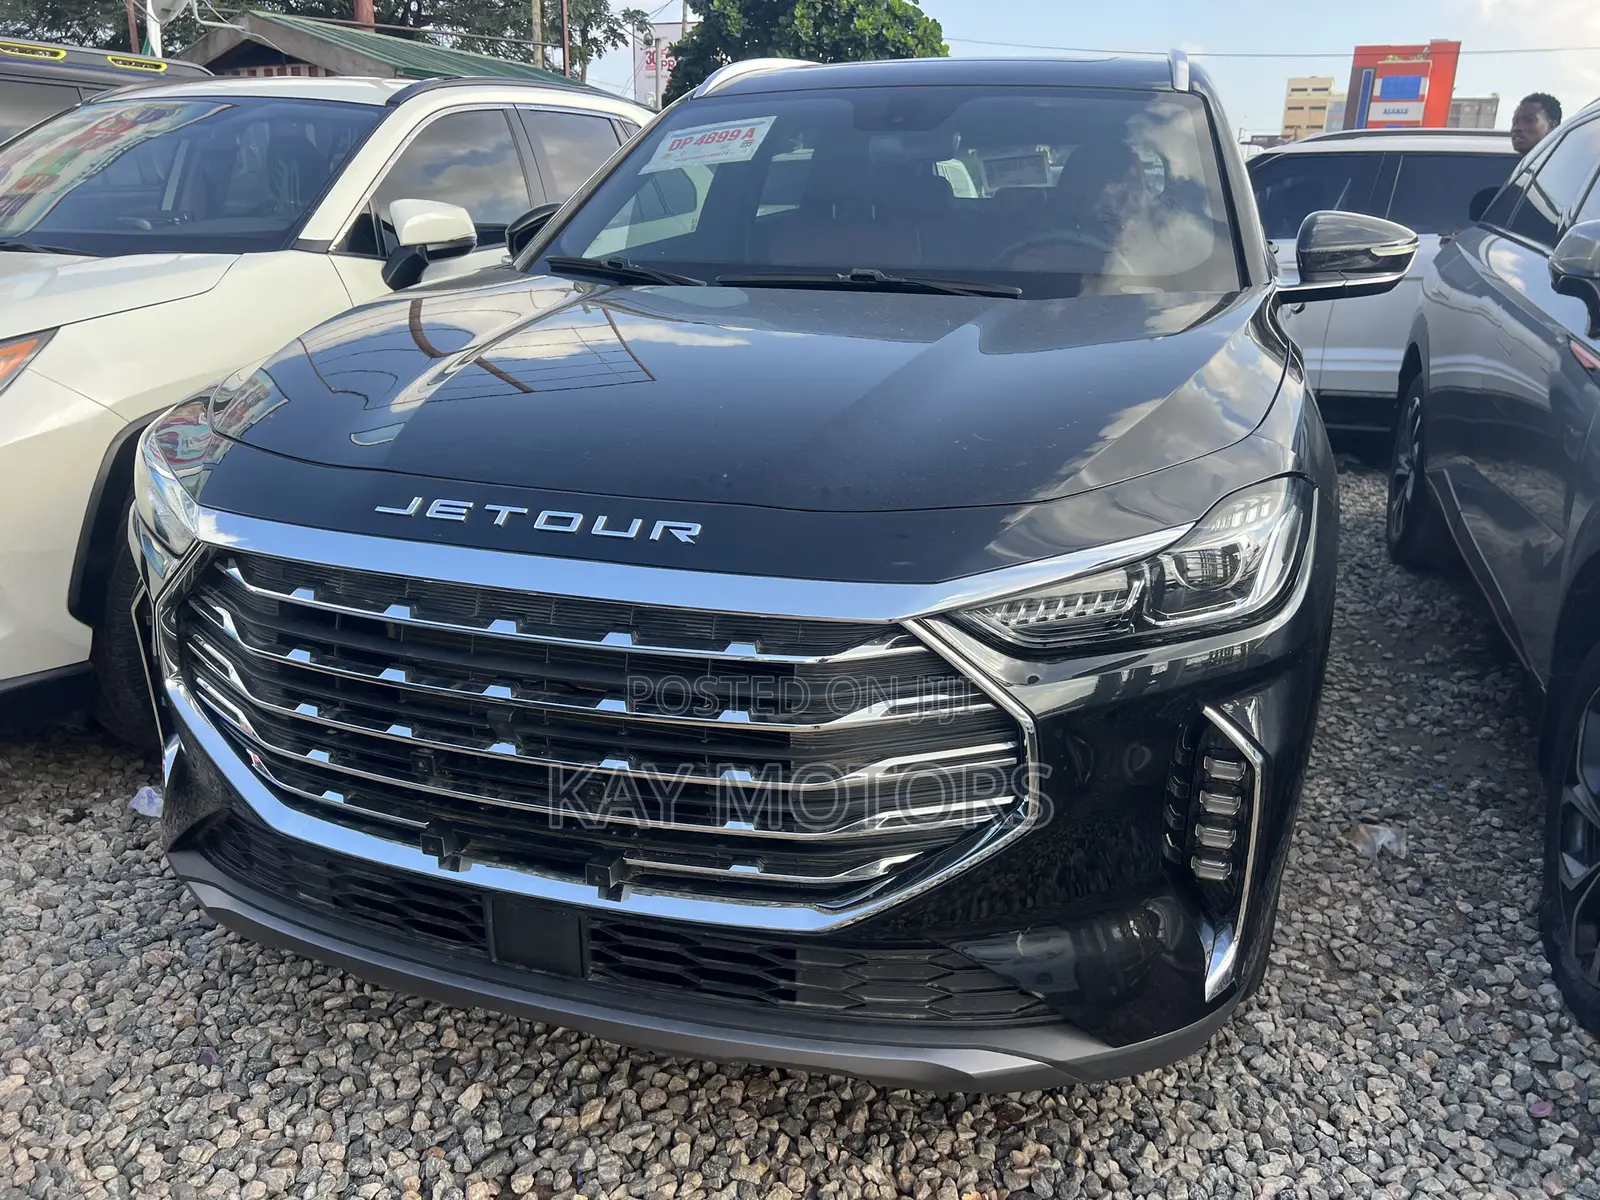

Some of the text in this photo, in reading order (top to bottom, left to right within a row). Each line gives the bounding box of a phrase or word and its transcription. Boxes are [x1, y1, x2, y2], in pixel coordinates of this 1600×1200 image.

[668, 127, 756, 152] DP 4899 A
[374, 496, 702, 545] JETOUR
